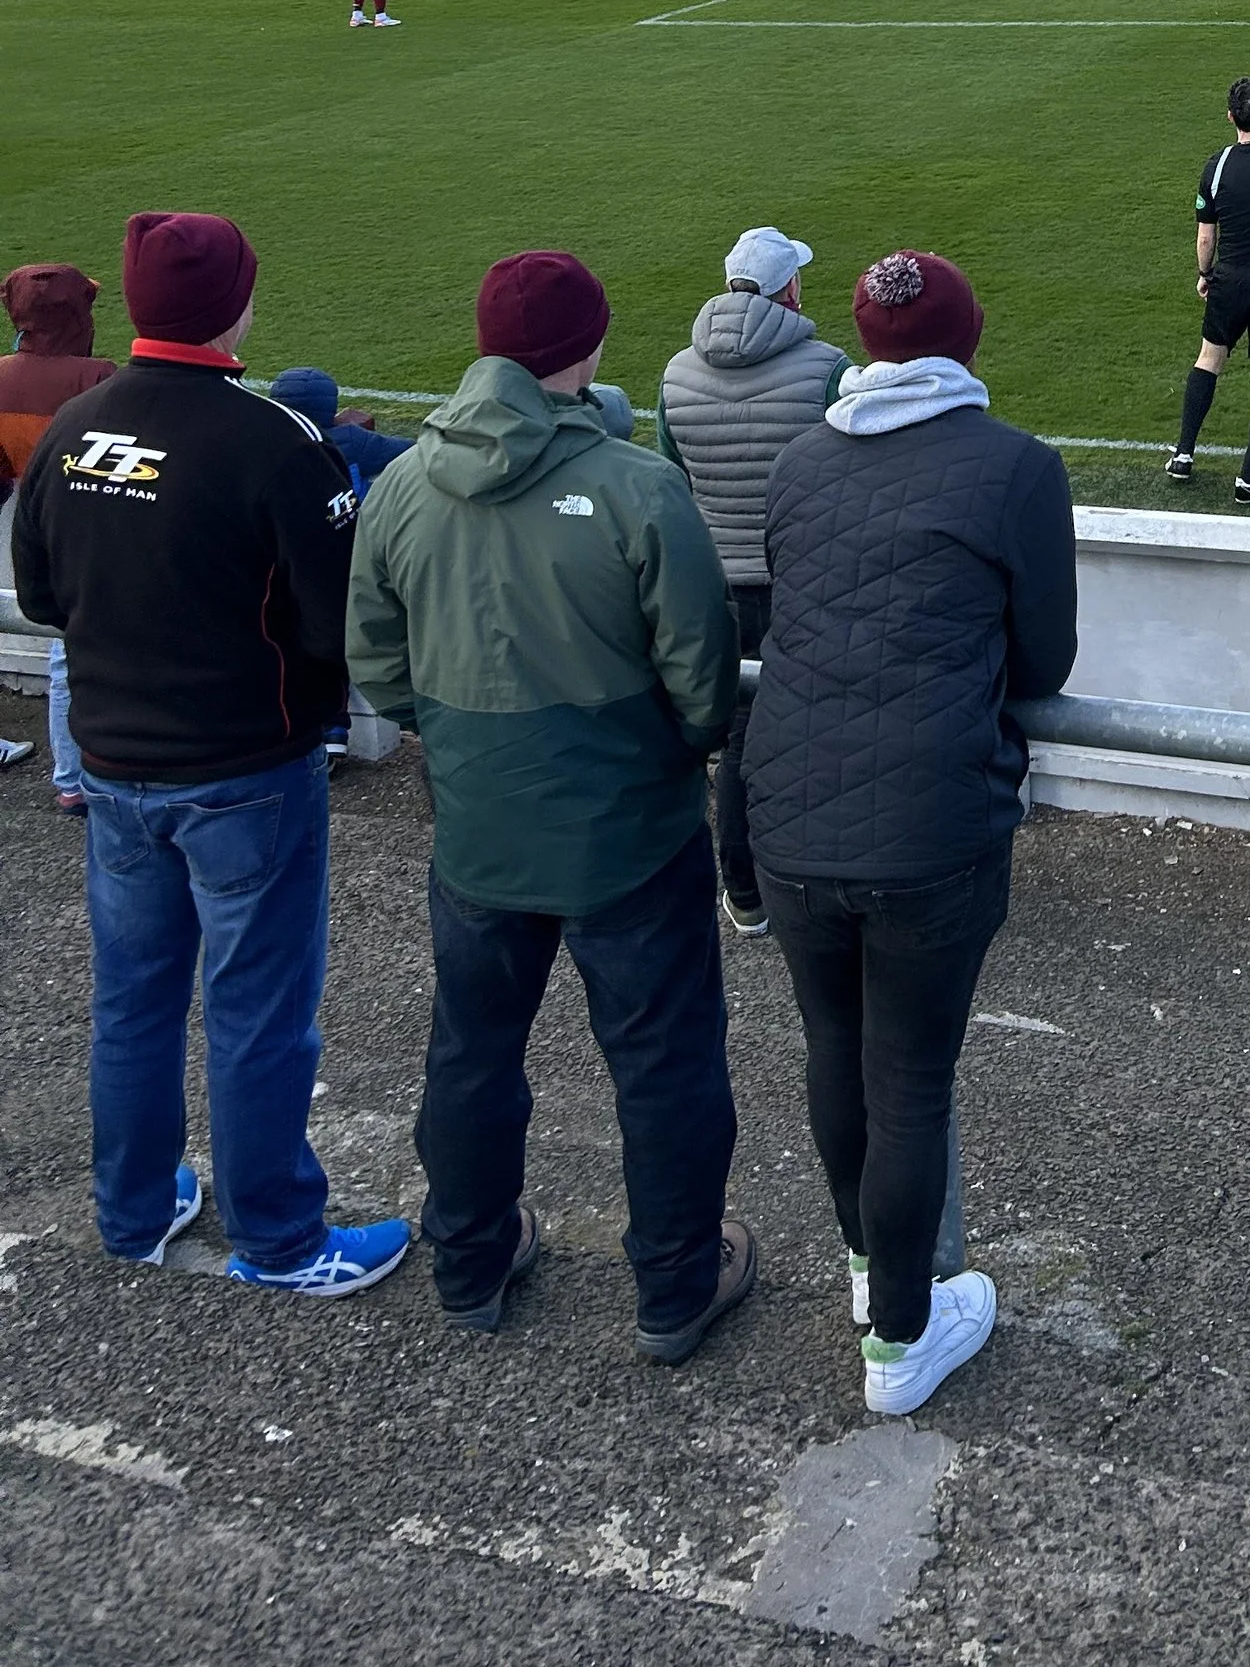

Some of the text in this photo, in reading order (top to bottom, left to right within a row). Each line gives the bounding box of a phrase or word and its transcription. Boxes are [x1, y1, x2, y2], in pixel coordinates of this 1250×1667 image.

[70, 481, 157, 502] ISLE OF MAN
